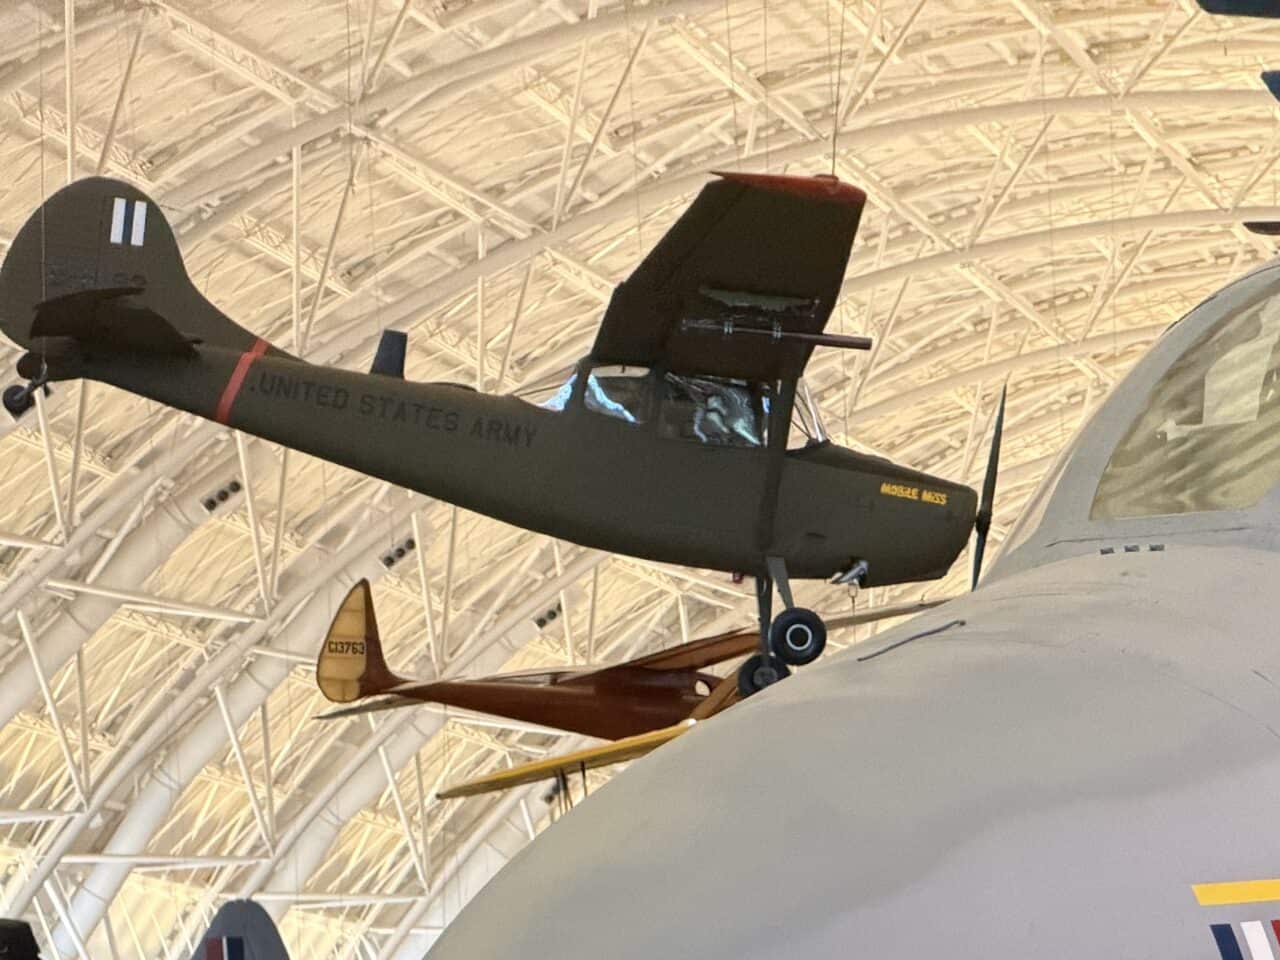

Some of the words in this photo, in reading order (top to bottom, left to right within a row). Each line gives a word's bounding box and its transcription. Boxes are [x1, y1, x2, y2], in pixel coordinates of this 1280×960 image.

[258, 372, 349, 410] UNITED
[360, 394, 459, 432] STATES
[469, 416, 538, 448] ARMY
